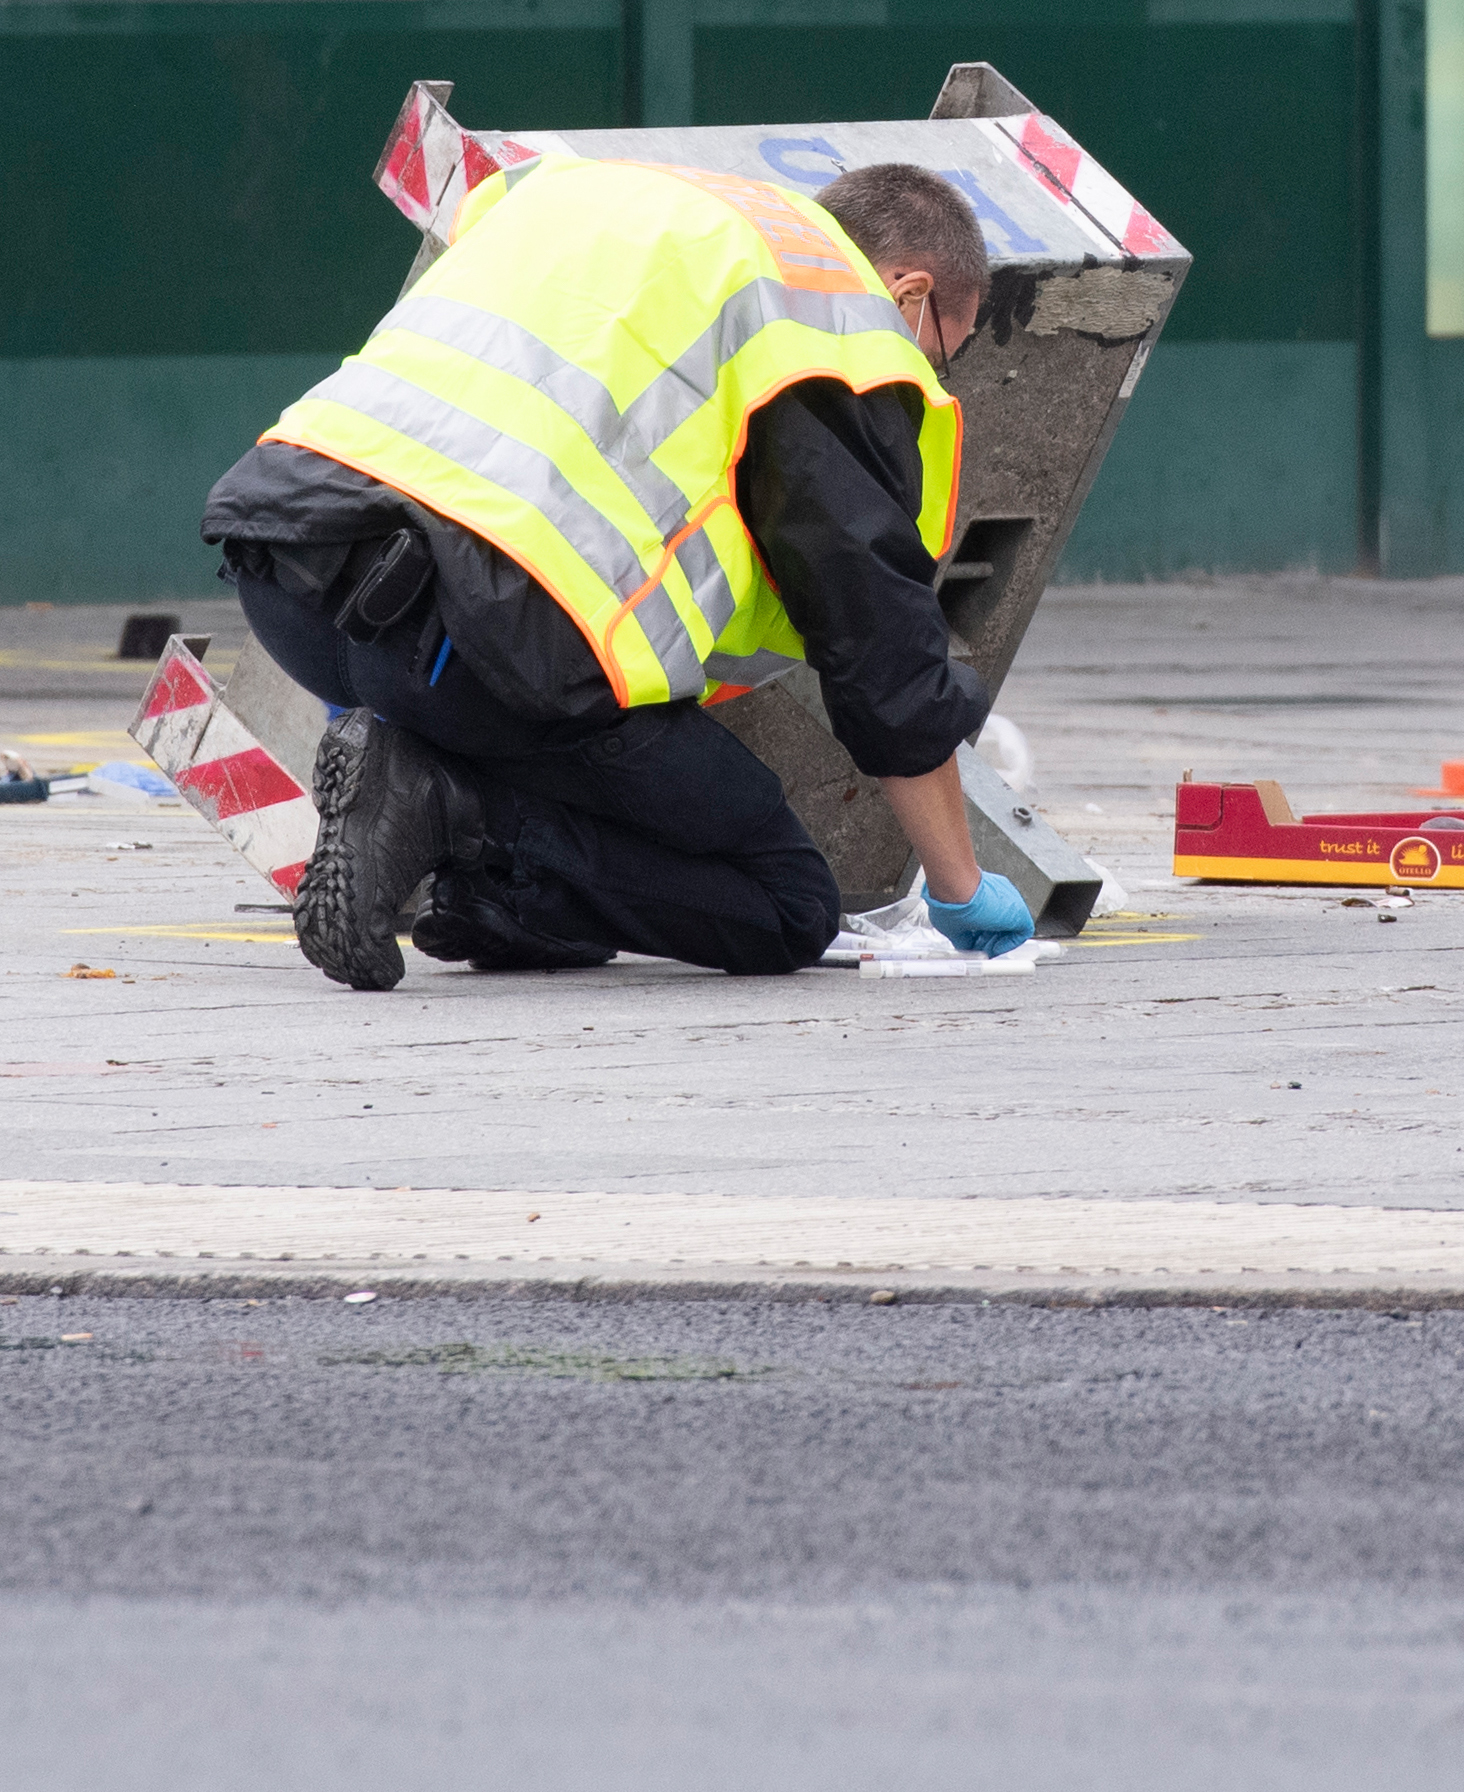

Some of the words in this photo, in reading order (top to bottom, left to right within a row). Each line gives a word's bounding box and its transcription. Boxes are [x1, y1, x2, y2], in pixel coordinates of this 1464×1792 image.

[1319, 839, 1363, 855] trust
[1366, 839, 1381, 855] it
[1398, 867, 1432, 875] OTELLO
